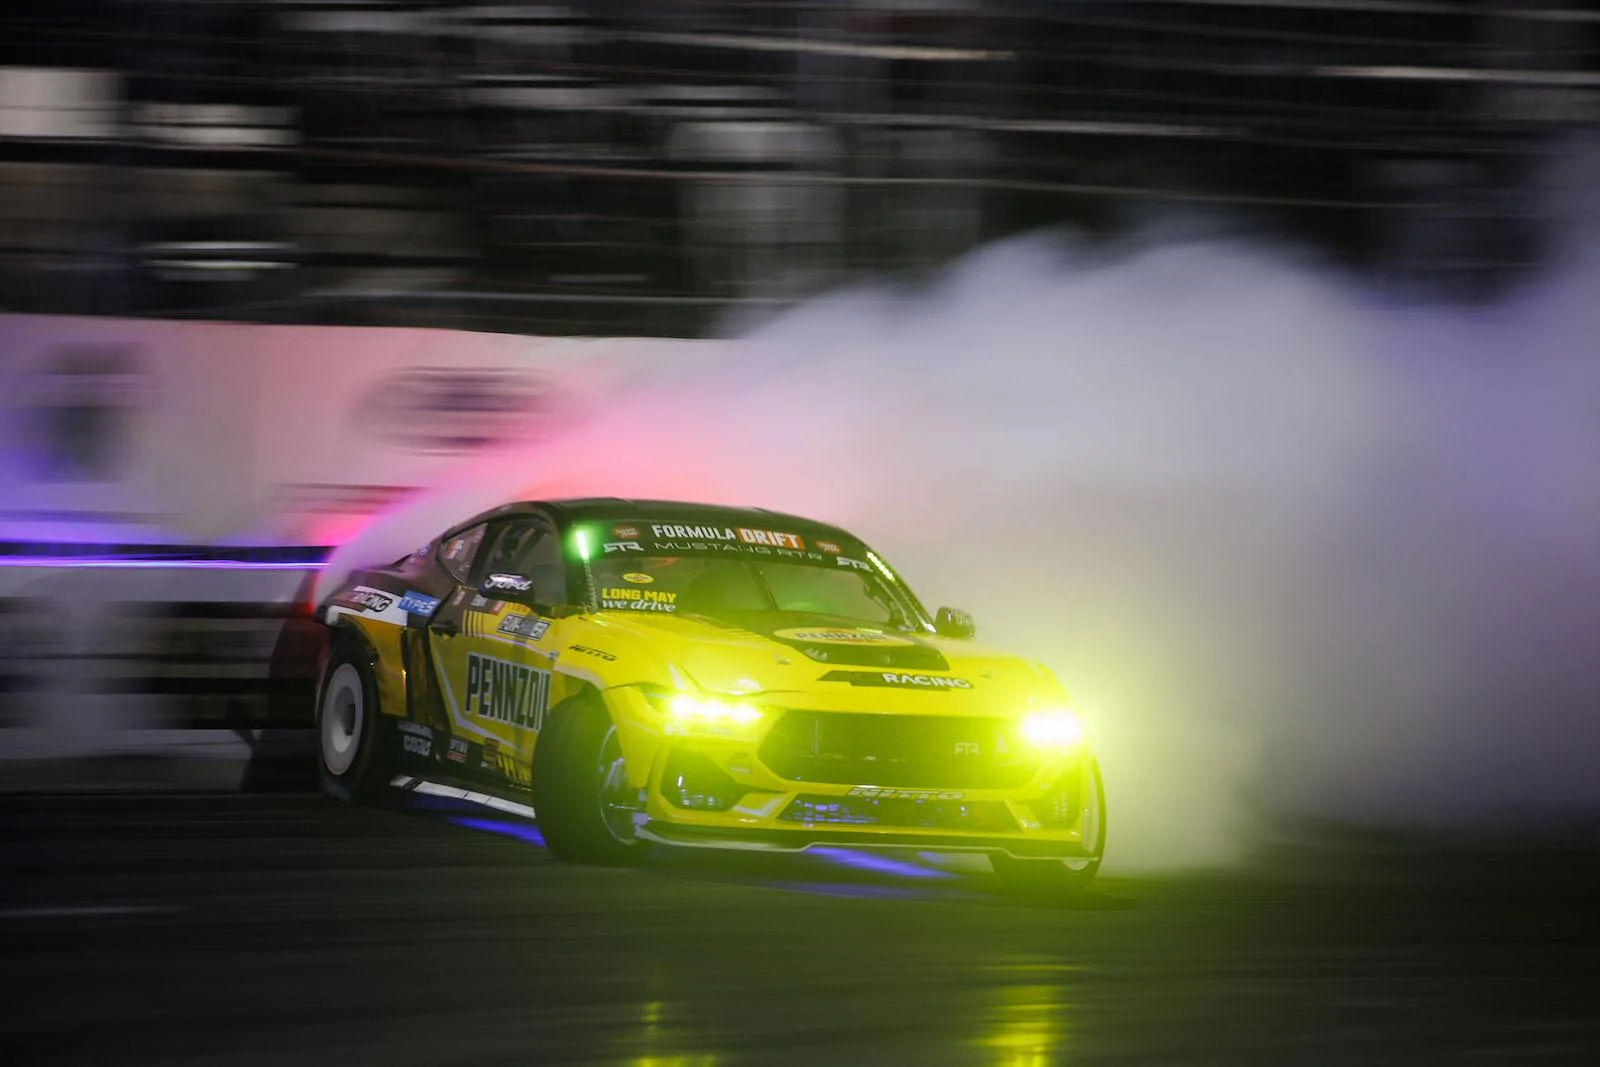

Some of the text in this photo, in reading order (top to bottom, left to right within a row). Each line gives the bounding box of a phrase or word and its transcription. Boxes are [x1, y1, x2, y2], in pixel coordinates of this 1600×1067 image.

[651, 524, 737, 541] FORMULA
[739, 527, 800, 549] DRIFT
[654, 541, 772, 555] MUSTANG
[484, 573, 532, 591] Ford
[602, 588, 677, 603] LONG MAY
[602, 599, 676, 612] we drive
[882, 673, 971, 689] RACING
[848, 787, 965, 800] NITTO
